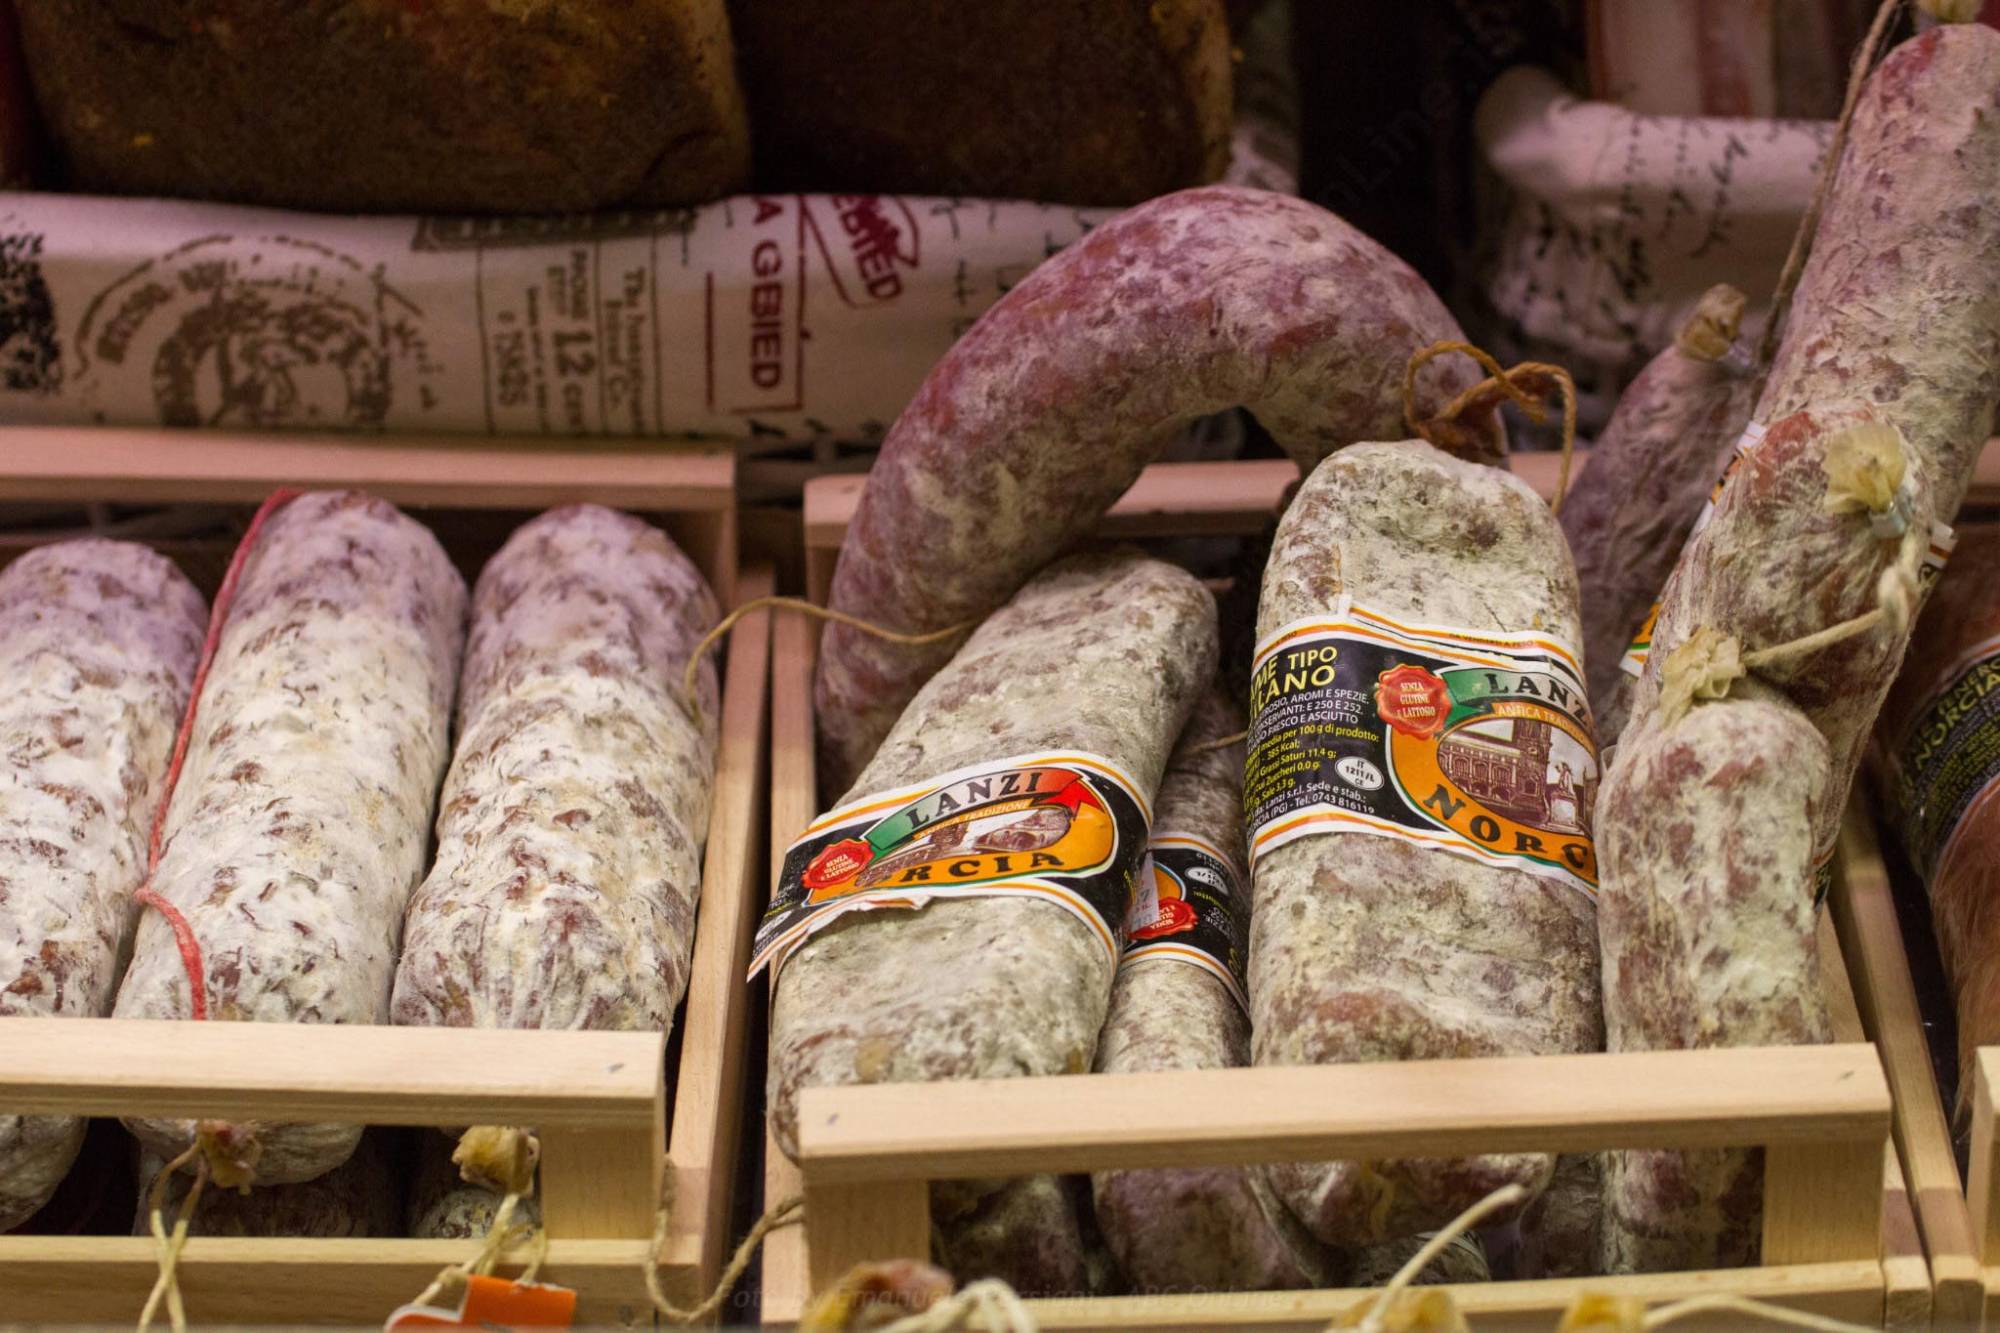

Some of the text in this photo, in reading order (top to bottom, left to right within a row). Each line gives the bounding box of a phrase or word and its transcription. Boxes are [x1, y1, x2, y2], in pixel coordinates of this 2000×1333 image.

[1288, 646, 1337, 670] TIPO
[1400, 680, 1424, 691] SENZA
[1290, 689, 1323, 705] AROMI
[1326, 688, 1332, 698] E
[1335, 688, 1370, 704] SPEZIE.
[1400, 693, 1430, 704] GLUTINE
[1307, 702, 1313, 711] E
[1315, 700, 1333, 710] 250
[1335, 699, 1341, 709] E
[1344, 701, 1363, 714] 252.
[1402, 706, 1435, 718] LATTOSIO
[1499, 704, 1541, 719] ANTICA
[1268, 711, 1359, 737] FRESCO E ASCIUTTO
[1915, 673, 2000, 771] NORCIA
[1283, 730, 1296, 742] per
[1300, 725, 1315, 735] 100
[1325, 724, 1334, 734] di
[1336, 725, 1379, 741] prodotto:
[1357, 760, 1364, 769] IT
[906, 772, 1043, 830] LANZI
[1265, 791, 1285, 809] Lanzi
[1306, 780, 1331, 792] Sede
[964, 800, 1029, 822] TRADIZIONE
[1271, 804, 1288, 818] (PG)
[1312, 791, 1336, 803] 0743
[824, 858, 853, 874] GLUTINE
[826, 853, 849, 868] SENZA
[826, 862, 860, 879] LATTOSIO
